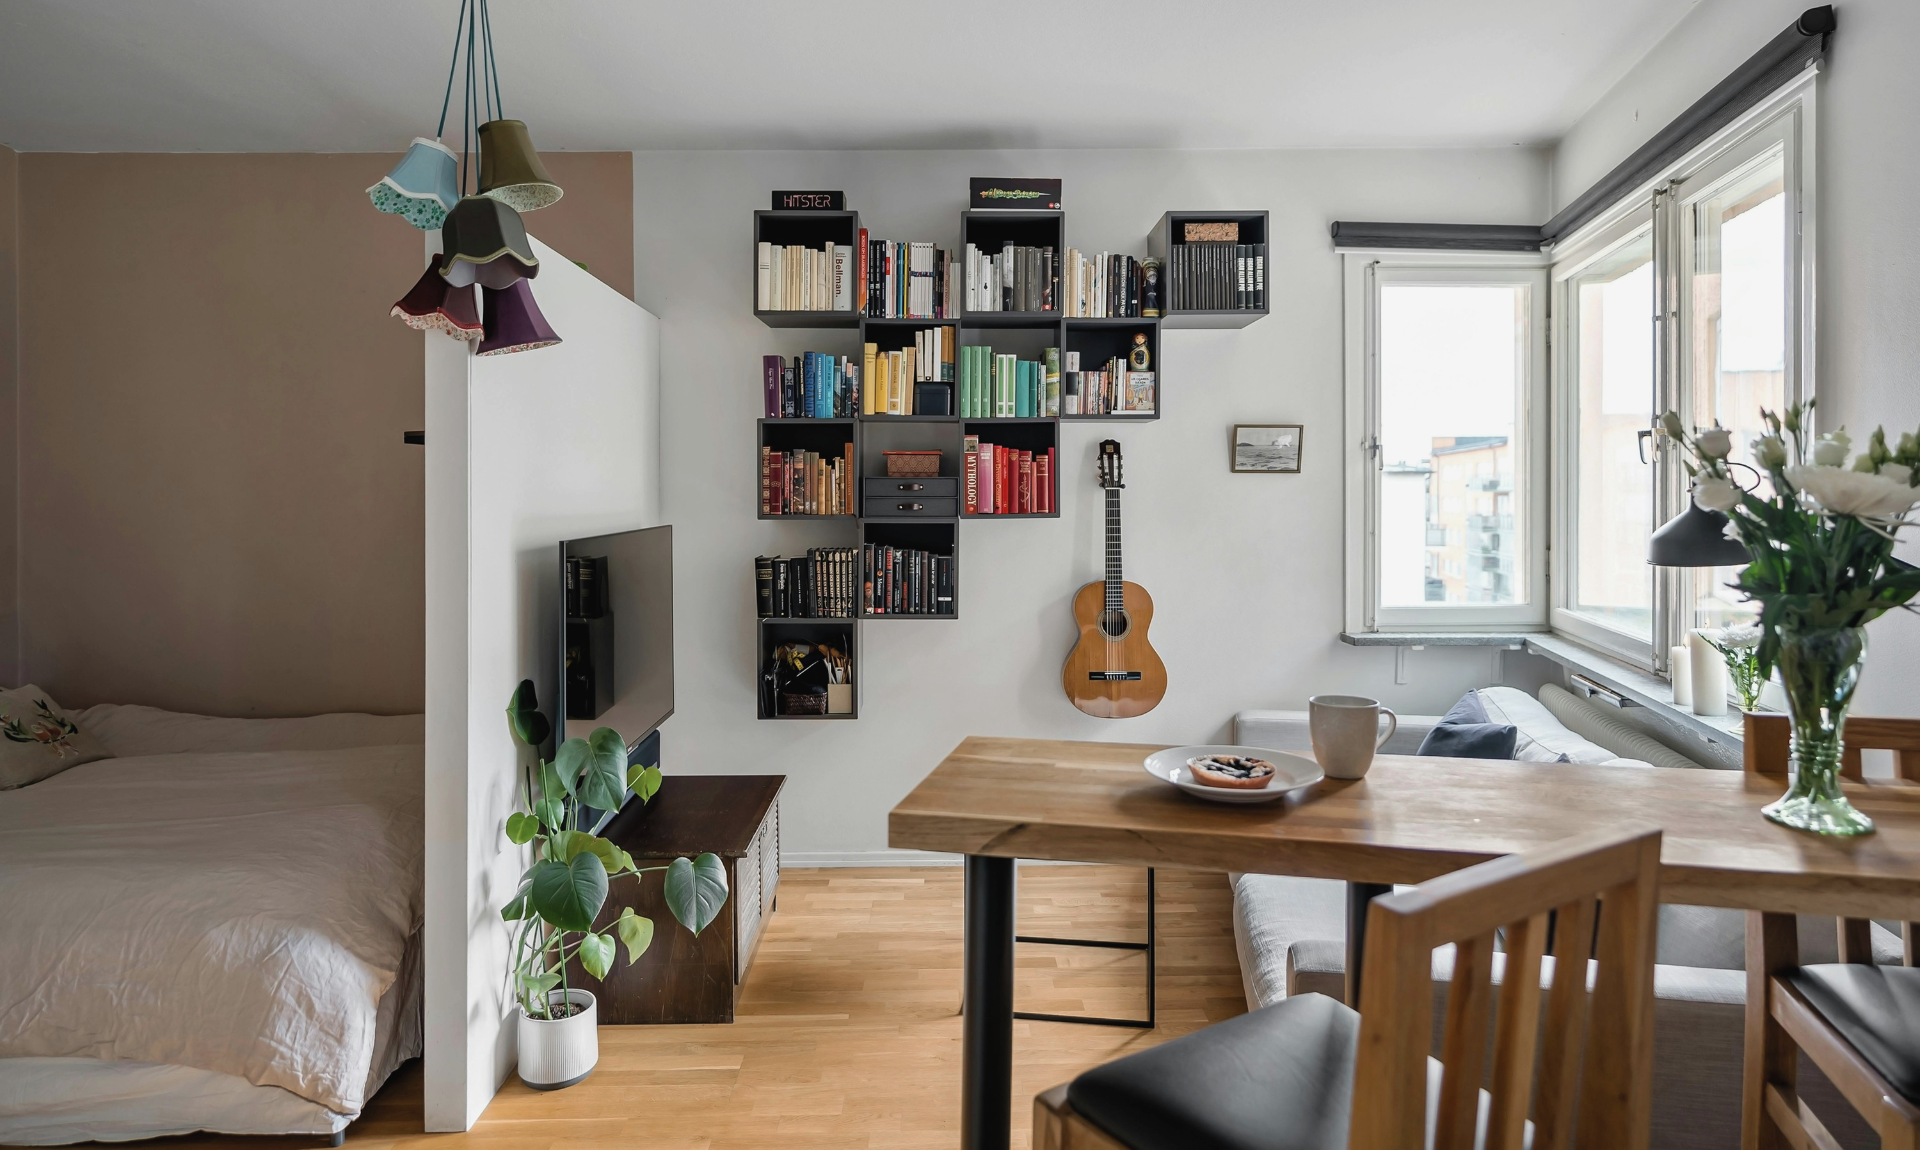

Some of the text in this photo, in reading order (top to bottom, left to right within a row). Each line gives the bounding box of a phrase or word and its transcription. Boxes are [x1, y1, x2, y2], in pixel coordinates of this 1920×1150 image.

[784, 195, 830, 208] HITSTER
[835, 258, 844, 297] Bellman.
[804, 352, 814, 415] PERSBRANDT
[968, 456, 976, 506] MYTHOLOGY
